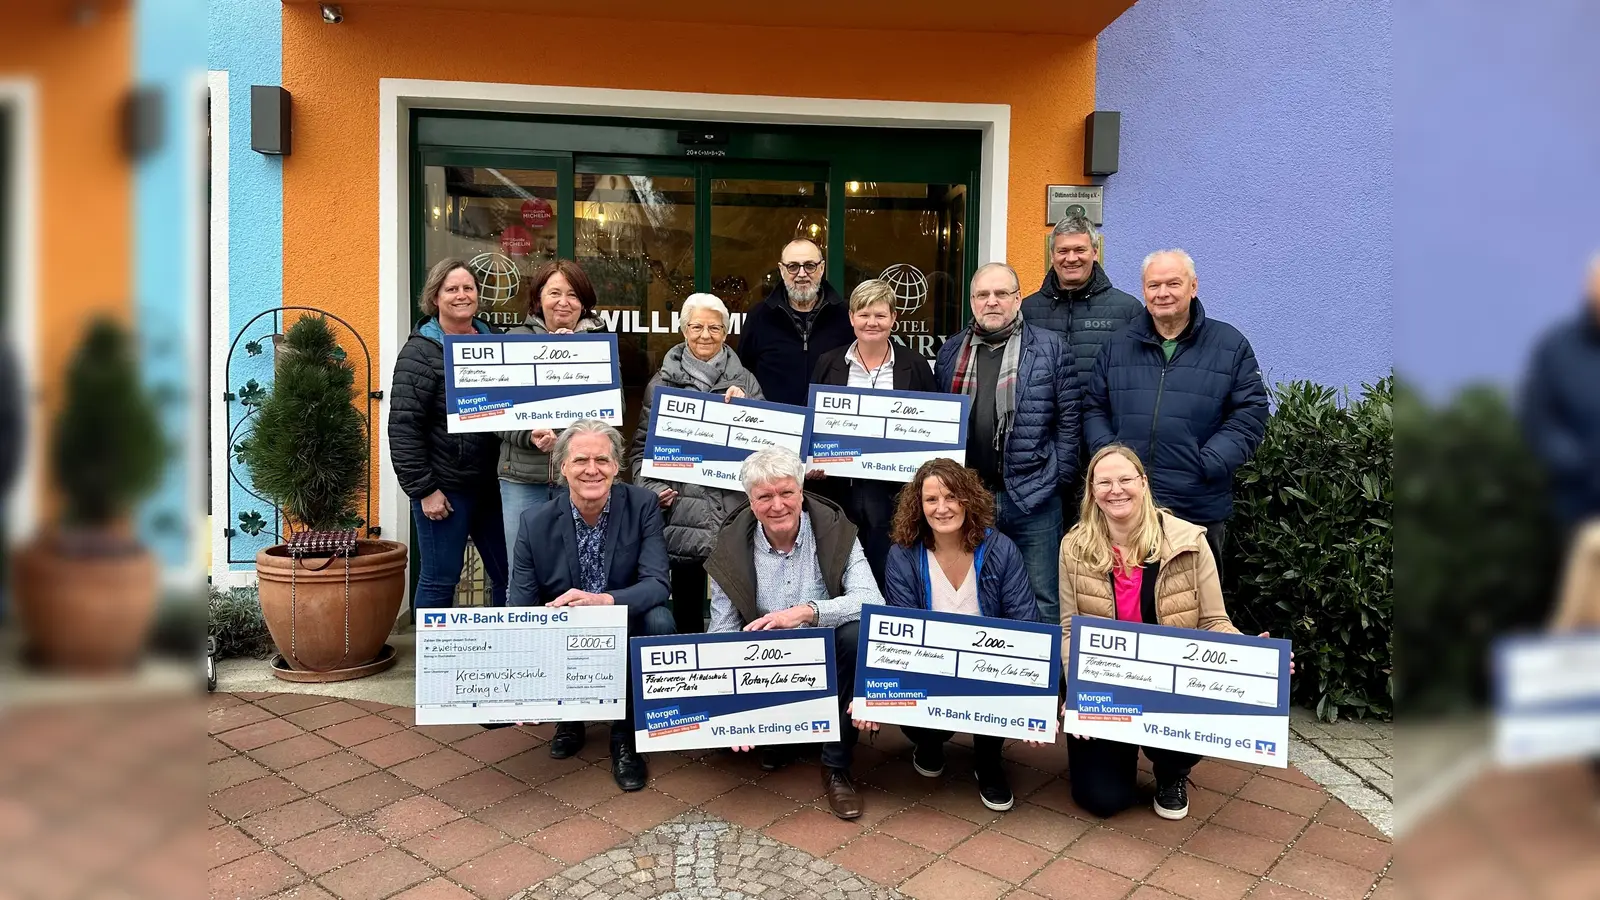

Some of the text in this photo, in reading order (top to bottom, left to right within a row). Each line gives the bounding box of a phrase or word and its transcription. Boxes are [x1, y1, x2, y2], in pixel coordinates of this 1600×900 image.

[477, 311, 523, 325] OTEL
[1084, 320, 1112, 329] BOSS
[890, 320, 930, 333] OTEL
[461, 347, 495, 360] EUR
[457, 396, 487, 405] Morgen
[667, 399, 696, 414] EUR
[823, 396, 852, 409] EUR
[458, 401, 512, 415] kann kommen.
[515, 410, 598, 420] VR-Bank Erding eG
[654, 446, 680, 454] Morgen
[861, 461, 897, 471] VR-Bank
[701, 468, 737, 480] VR-Bank
[450, 611, 569, 625] VR-Bank Erding eG
[879, 620, 914, 638] EUR
[1089, 633, 1127, 651] EUR
[650, 650, 688, 666] EUR
[744, 643, 792, 661] 2.000.-
[1182, 643, 1238, 665] 2.000.-
[456, 668, 547, 682] Kreismusikschule
[1000, 663, 1018, 676] Club
[566, 672, 614, 683] Rotary Club
[740, 671, 817, 688] Rotary Club Erding
[455, 684, 490, 697] Erding
[866, 680, 899, 690] Morgen
[867, 690, 926, 698] kann kommen.
[1078, 693, 1112, 704] Morgen
[646, 708, 679, 720] Morgen
[1079, 704, 1141, 714] kann kommen.
[648, 714, 708, 730] kann kommen.
[927, 706, 1025, 727] VR-Bank Erding eG
[711, 722, 809, 736] VR-Bank Erding eG
[1143, 723, 1252, 749] VR-Bank Erding eG
